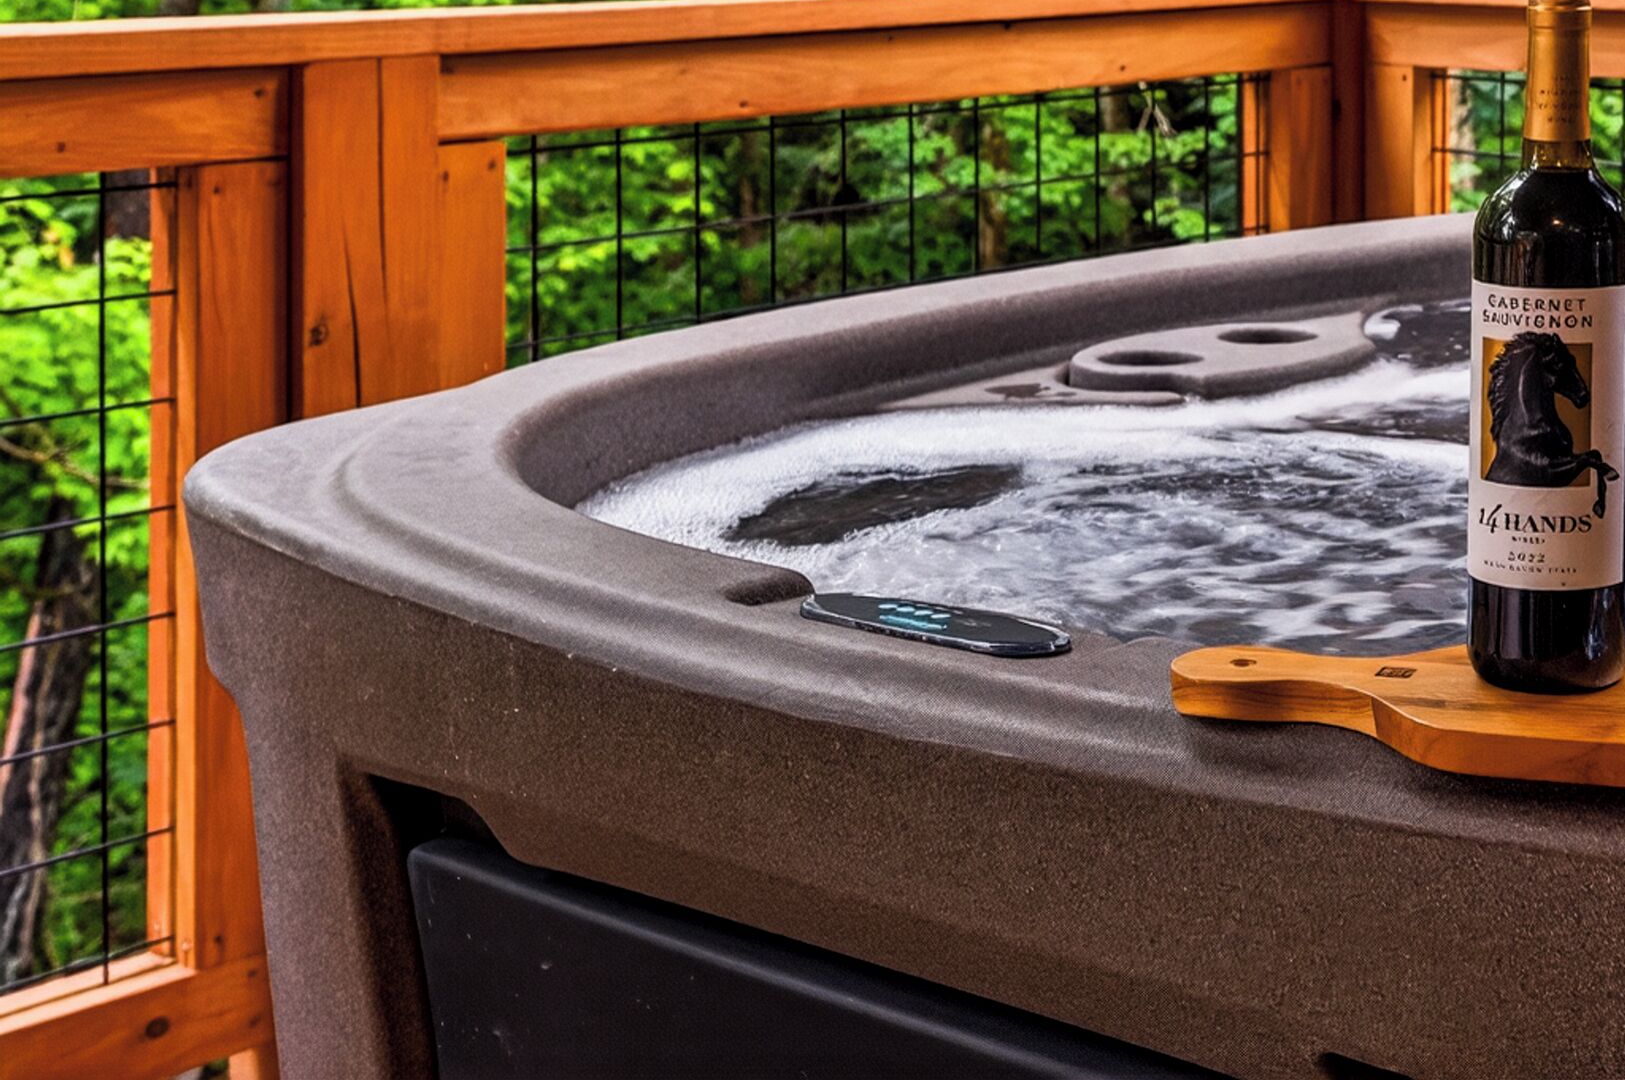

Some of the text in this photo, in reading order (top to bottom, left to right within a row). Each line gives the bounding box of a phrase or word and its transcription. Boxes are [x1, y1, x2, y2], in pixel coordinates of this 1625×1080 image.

[1488, 294, 1586, 311] CABERNET
[1482, 309, 1593, 328] SAUVIGNON
[1479, 504, 1592, 533] 14 HANDS
